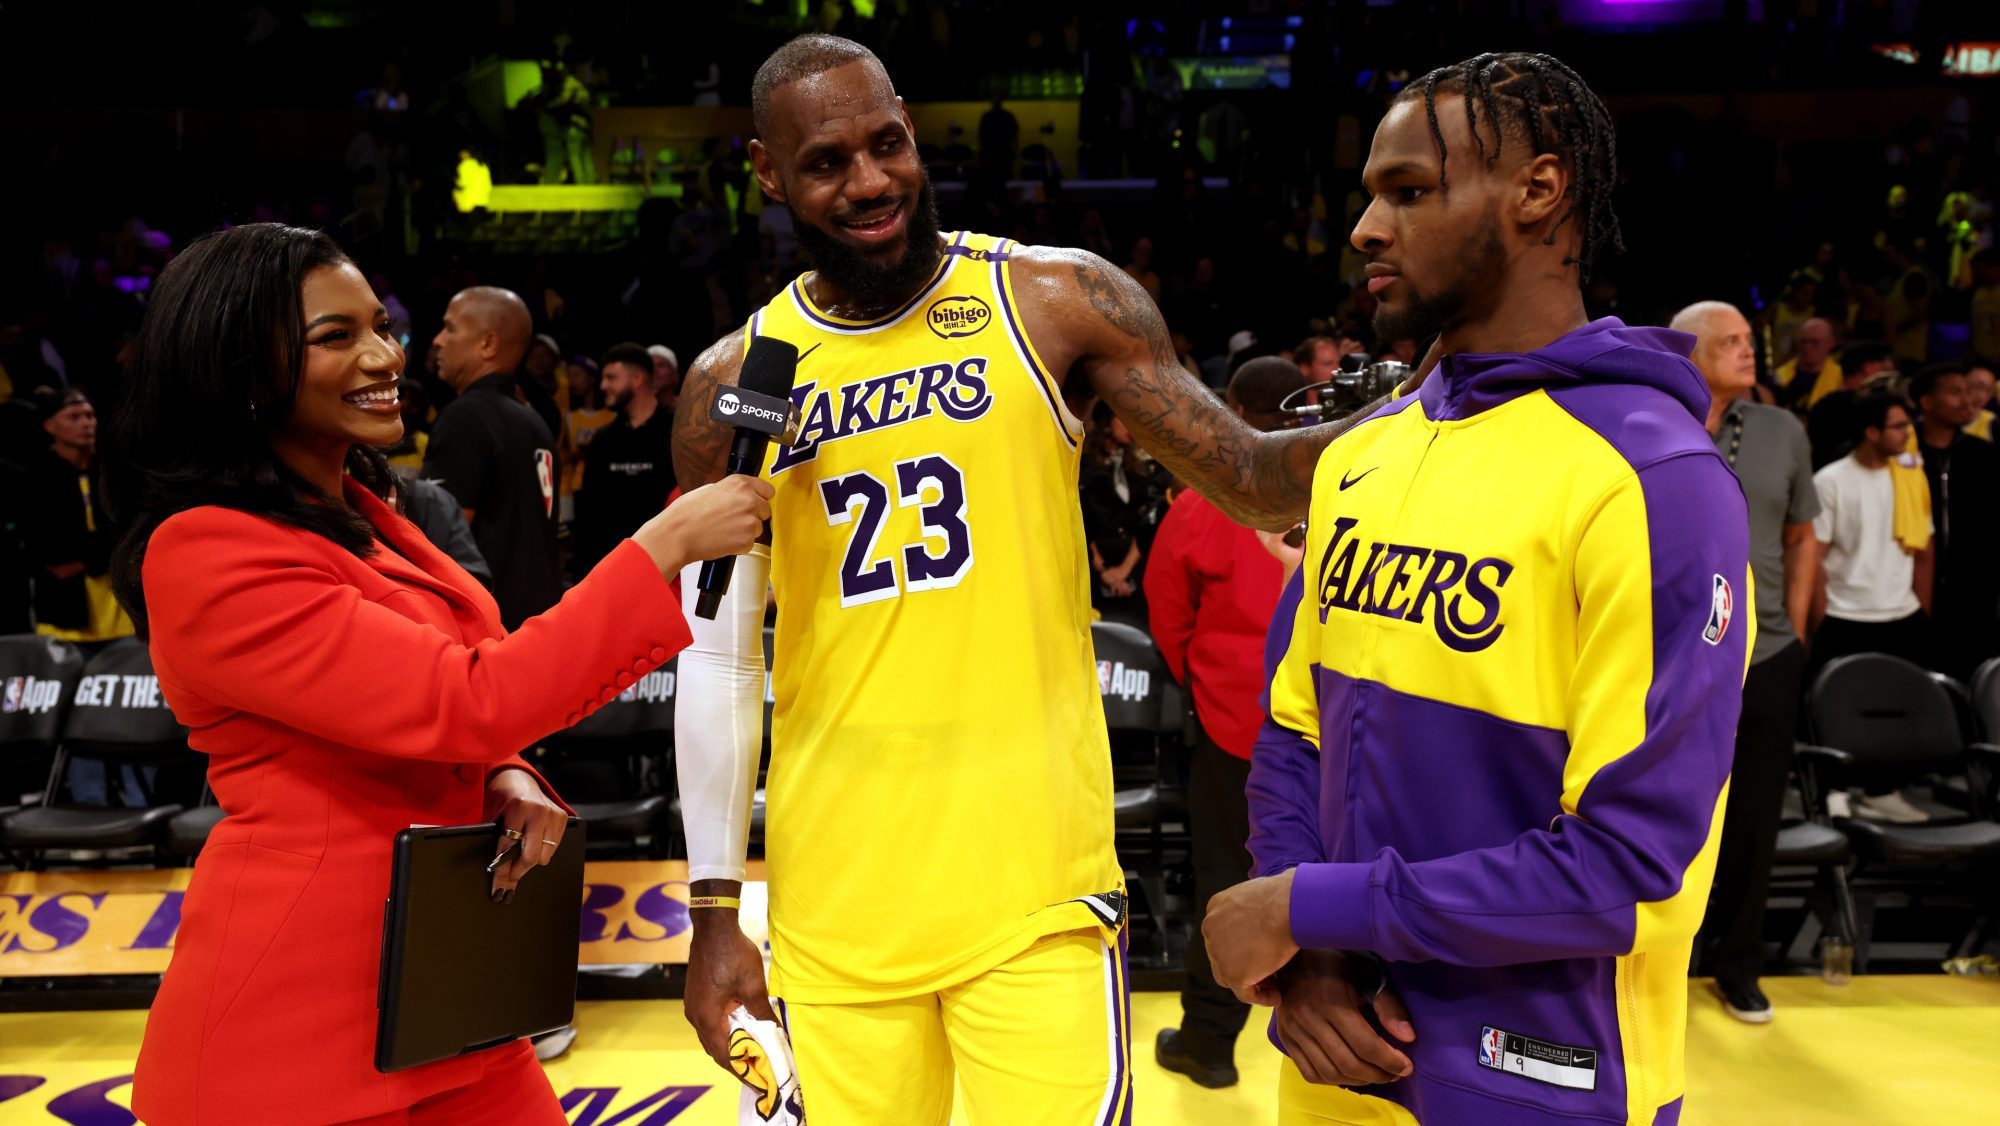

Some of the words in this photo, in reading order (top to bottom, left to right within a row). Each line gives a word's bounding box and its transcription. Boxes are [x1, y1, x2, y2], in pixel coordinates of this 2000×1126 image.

[932, 306, 988, 323] bibigo
[741, 404, 784, 423] SPORTS
[770, 356, 995, 478] LAKERS
[817, 452, 975, 609] 23
[1318, 516, 1515, 653] LAKERS
[20, 675, 62, 715] App
[74, 674, 121, 707] GET
[121, 674, 161, 708] THE
[637, 671, 675, 703] App
[1110, 661, 1150, 702] App
[1512, 1040, 1519, 1050] L
[1527, 1042, 1569, 1057] ENGINEERED
[1515, 1057, 1524, 1072] 9
